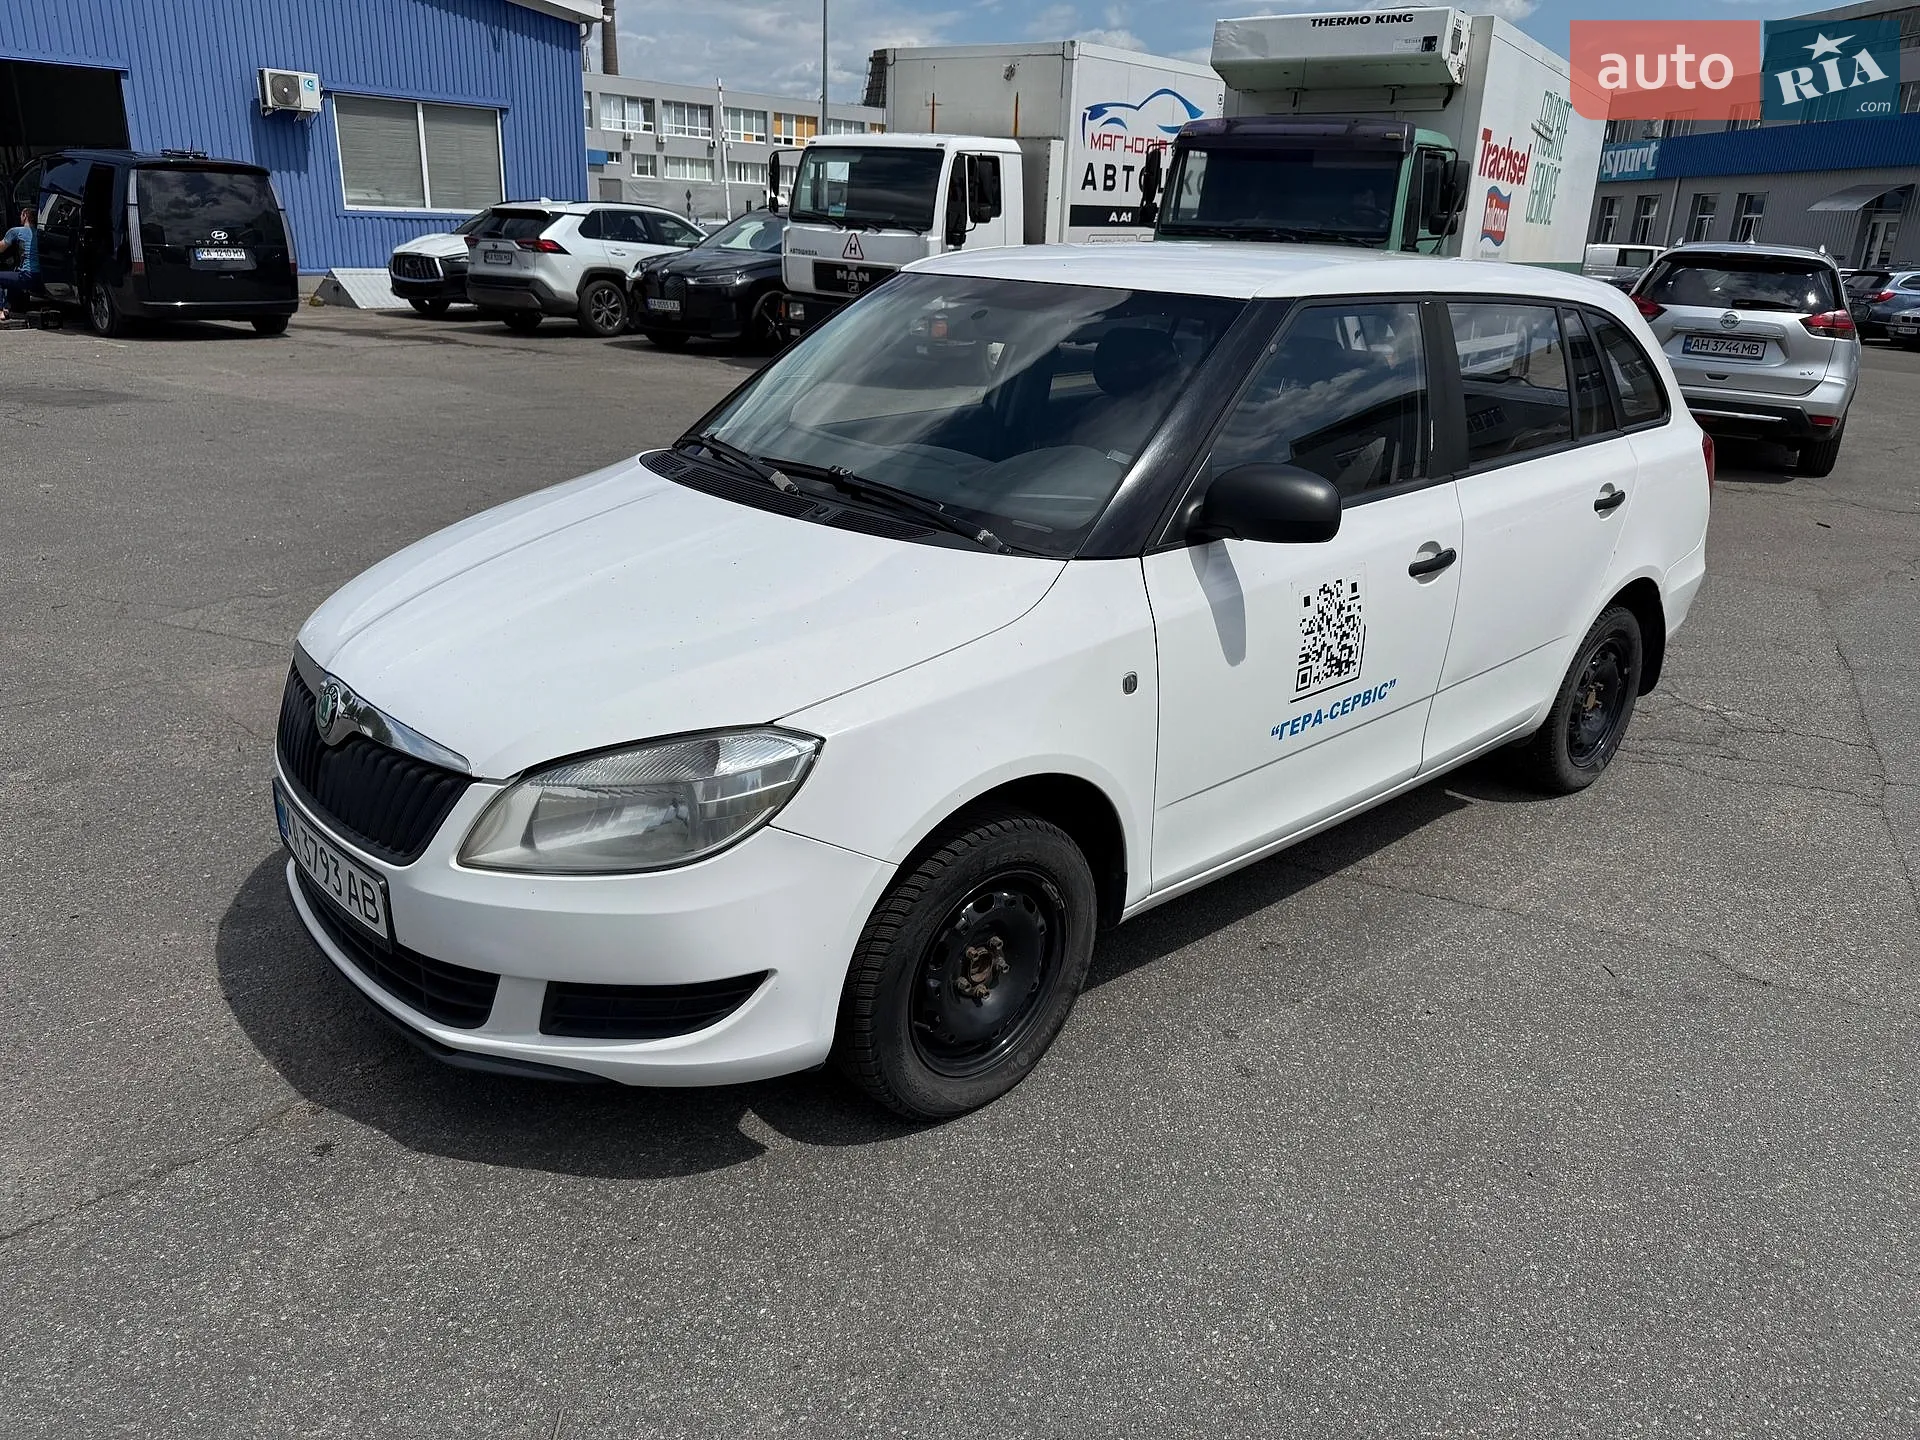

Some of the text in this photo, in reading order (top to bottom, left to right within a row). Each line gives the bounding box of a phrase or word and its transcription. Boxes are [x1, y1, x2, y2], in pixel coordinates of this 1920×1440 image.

[1310, 13, 1414, 28] THERMO KING
[1478, 128, 1532, 185] Trachsel
[836, 269, 870, 282] MAN
[1691, 338, 1760, 355] AH 3744 MB
[301, 826, 342, 897] 3793
[347, 869, 379, 924] AB
